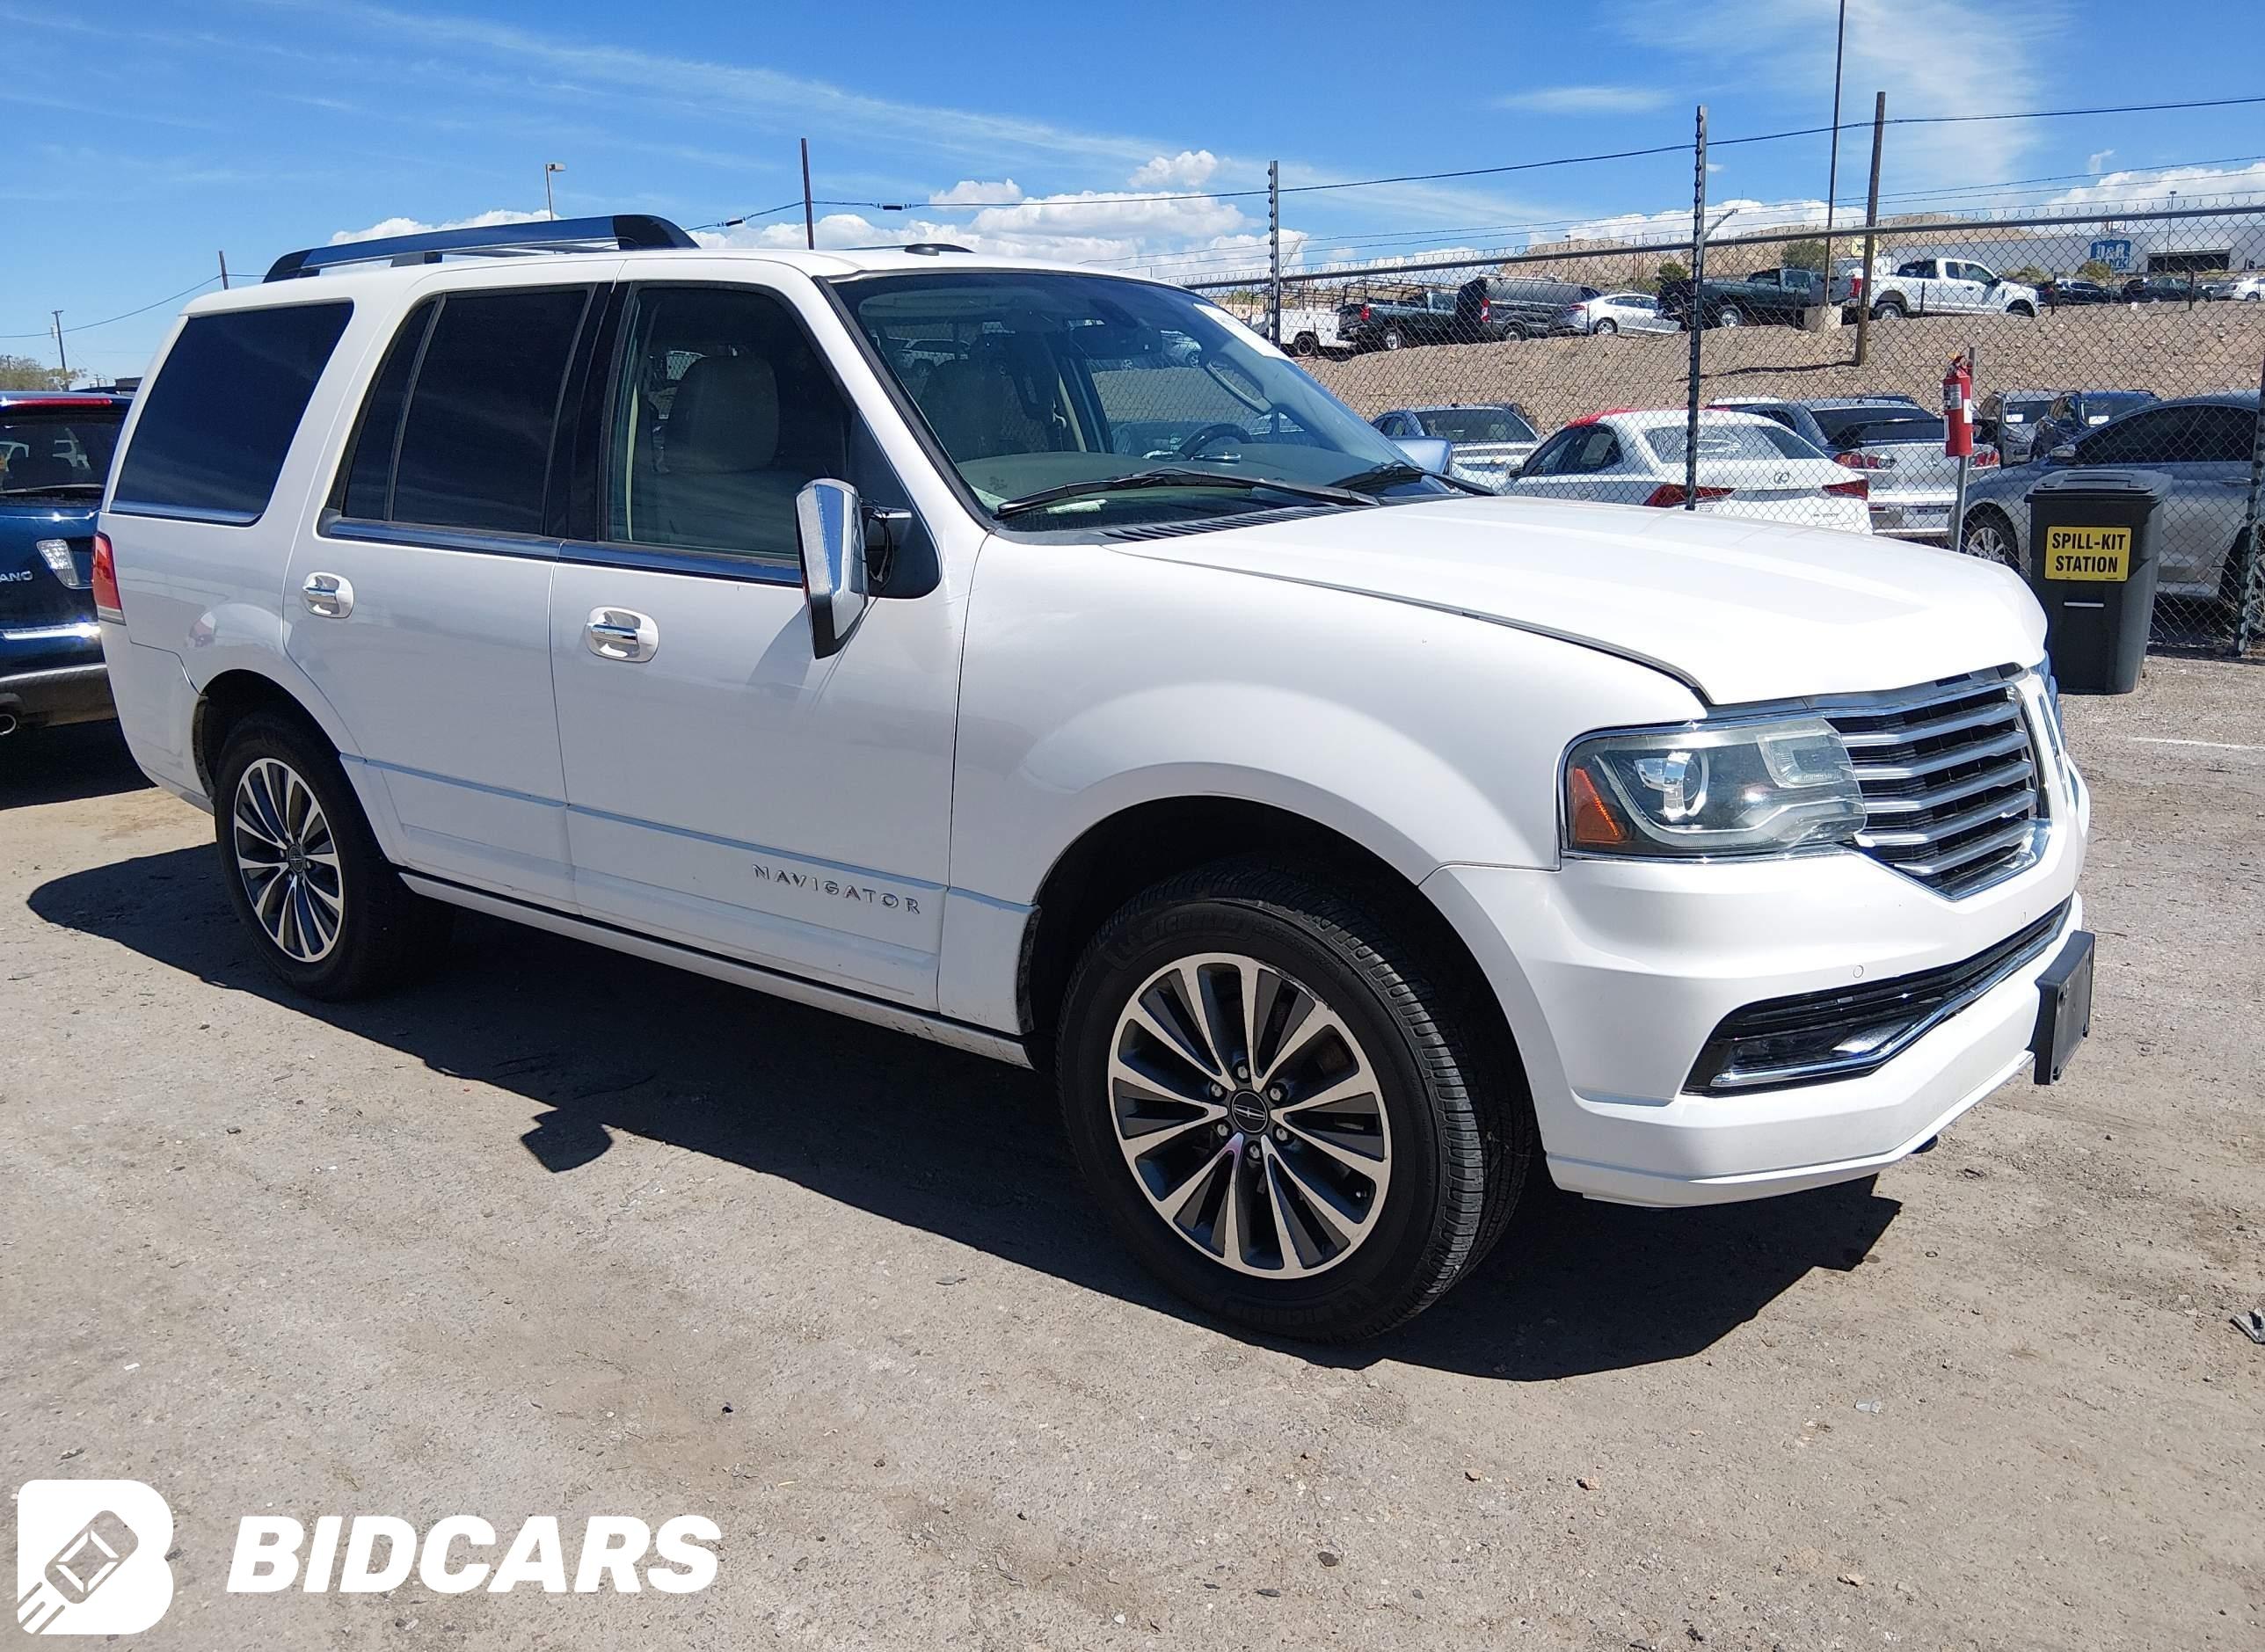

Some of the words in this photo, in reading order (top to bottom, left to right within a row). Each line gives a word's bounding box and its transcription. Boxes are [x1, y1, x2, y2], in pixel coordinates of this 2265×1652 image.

[2051, 532, 2126, 550] SPILL-KIT
[2055, 555, 2118, 573] STATION
[752, 863, 921, 914] NAVIGATOR
